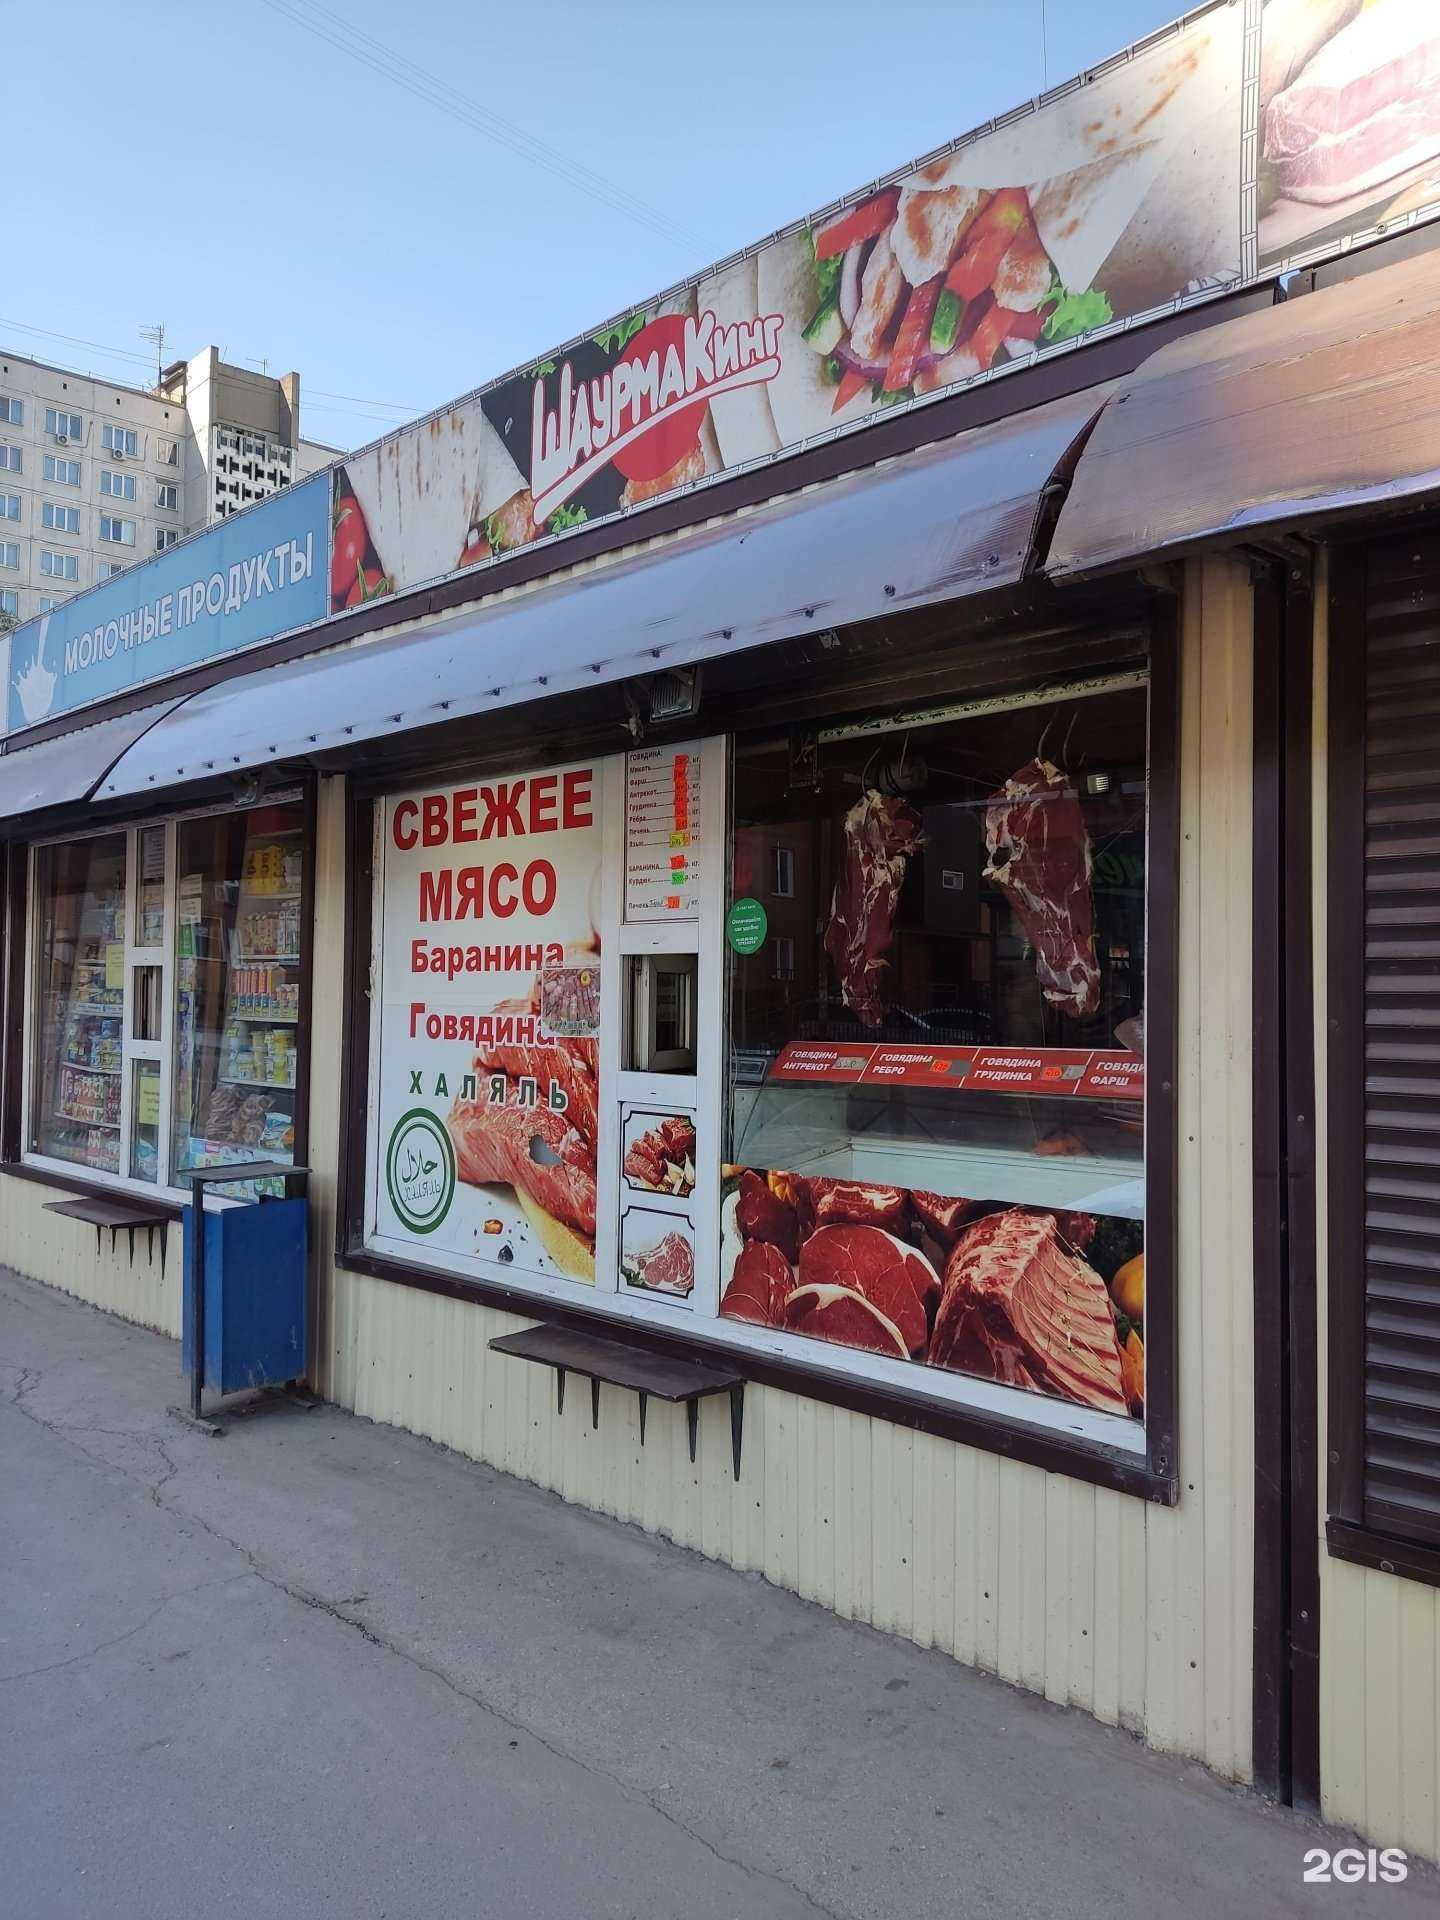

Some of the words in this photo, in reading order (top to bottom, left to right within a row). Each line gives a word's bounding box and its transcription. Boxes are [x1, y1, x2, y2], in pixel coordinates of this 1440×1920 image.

[64, 593, 173, 676] МОЛОЧНЫЕ
[177, 531, 314, 629] ПРОДУКТЫ
[629, 789, 657, 799] Антрекот
[393, 769, 593, 850] СВЕЖЕЕ
[629, 802, 657, 812] Грудинка
[419, 859, 557, 922] МЯСО
[411, 939, 564, 982] Баранина
[790, 1050, 838, 1060] ГОВЯДИНА
[879, 1053, 934, 1063] ГОВЯДИНА
[783, 1062, 830, 1071] АНТРЕКОТ
[980, 1057, 1042, 1068] ГОВЯДИНА
[872, 1065, 906, 1075] РЕБРО
[974, 1070, 1033, 1081] ГРУДИНКА
[1090, 1076, 1130, 1086] ФАРШ
[402, 1147, 438, 1183] حلال
